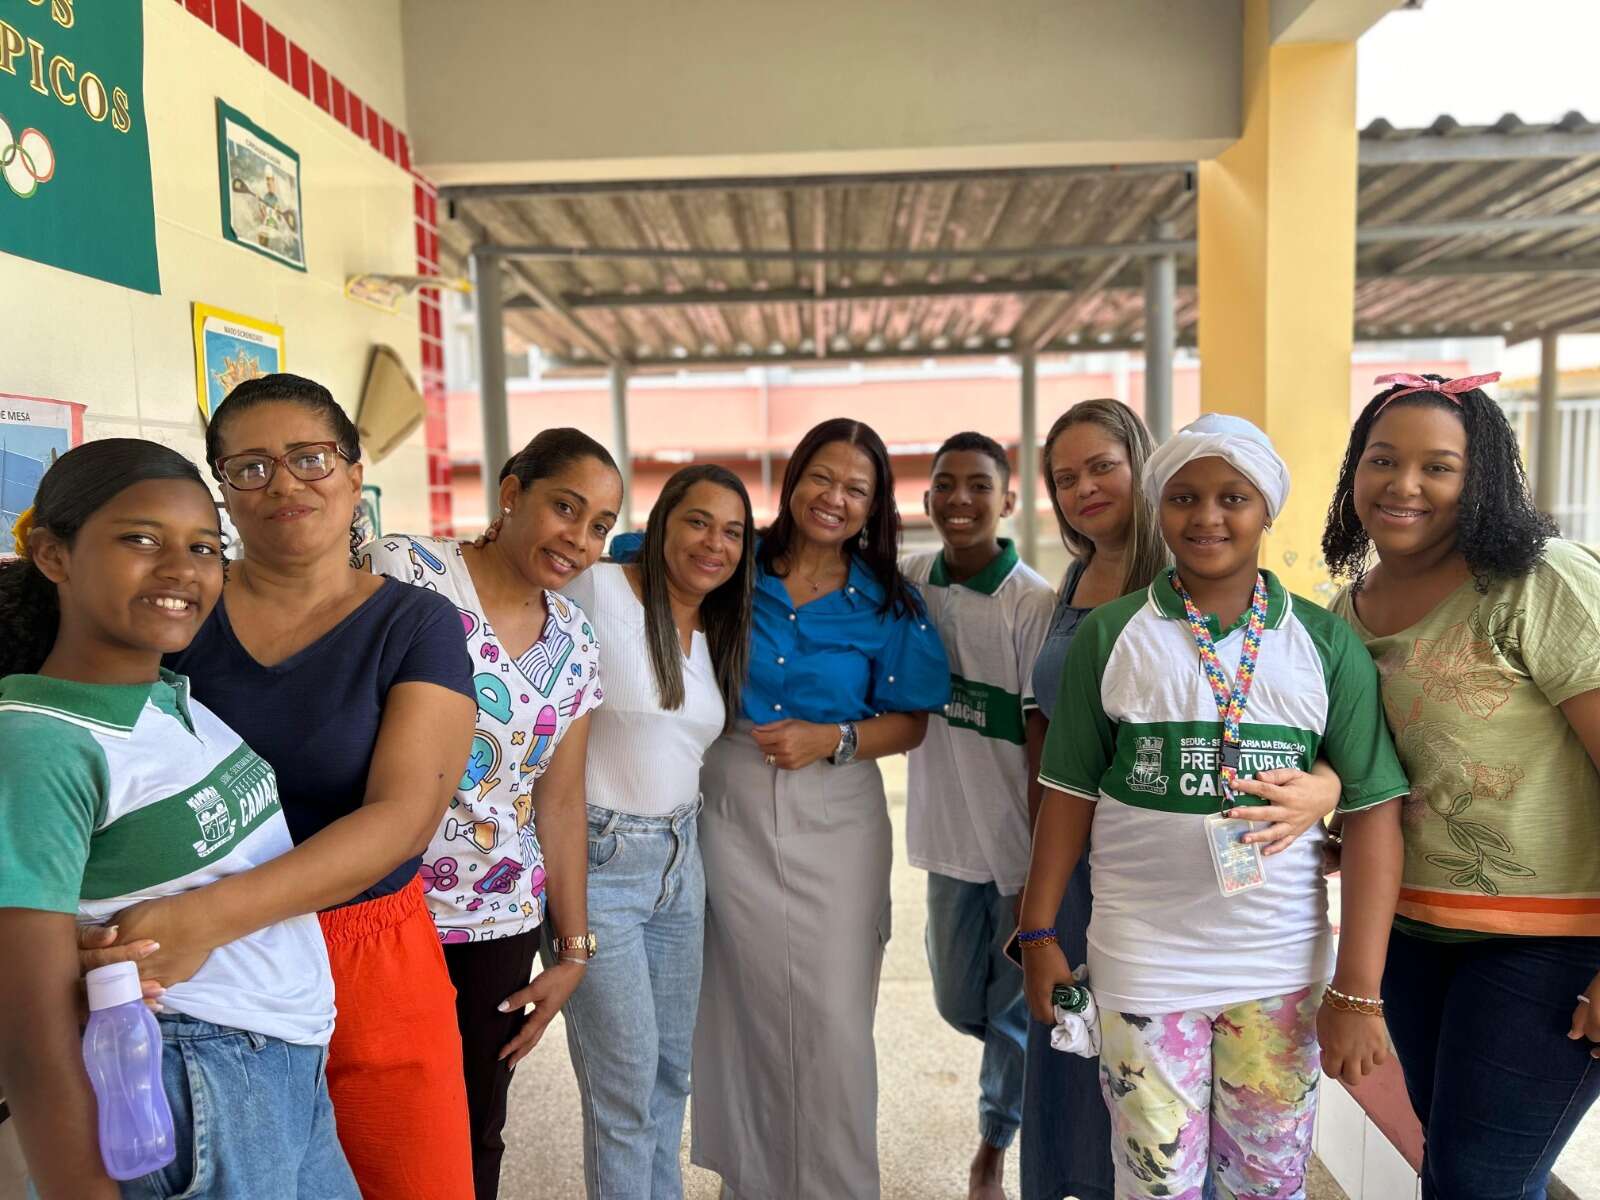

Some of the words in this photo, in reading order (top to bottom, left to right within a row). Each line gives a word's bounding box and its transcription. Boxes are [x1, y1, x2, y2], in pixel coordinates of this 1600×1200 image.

[0, 20, 131, 133] PICOS
[8, 411, 31, 421] MESA
[1180, 738, 1206, 747] SEDUC
[1212, 739, 1261, 749] SEARIA
[1261, 741, 1272, 749] DA
[1180, 752, 1285, 771] PREITURA
